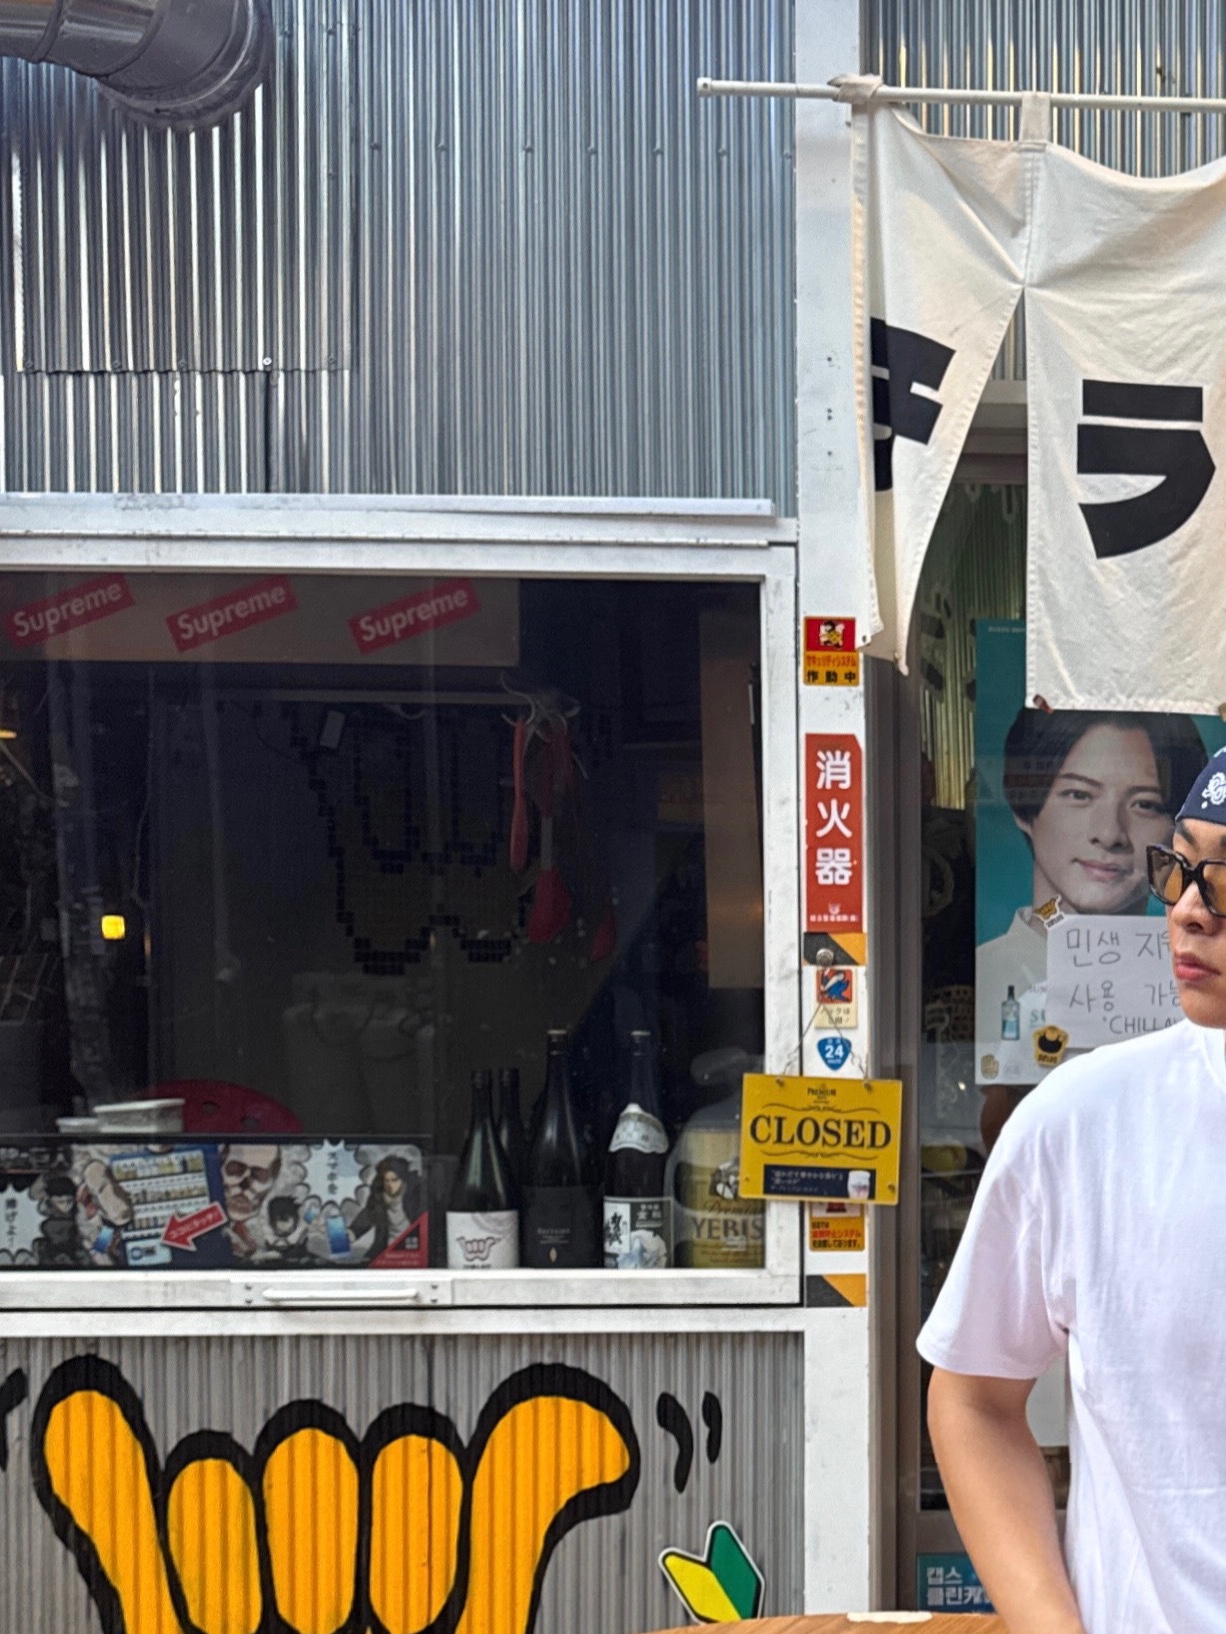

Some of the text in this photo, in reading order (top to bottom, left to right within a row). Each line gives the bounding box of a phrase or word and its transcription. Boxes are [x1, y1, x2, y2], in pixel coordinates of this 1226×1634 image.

[14, 580, 124, 638] Supreme
[178, 583, 288, 641] Supreme
[359, 586, 469, 643] Supreme
[807, 670, 856, 683] 作動中
[816, 751, 852, 885] 消火器
[1066, 928, 1120, 967] 민생
[1069, 980, 1114, 1013] 사용
[825, 1045, 844, 1059] 24
[749, 1114, 892, 1149] CLOSED
